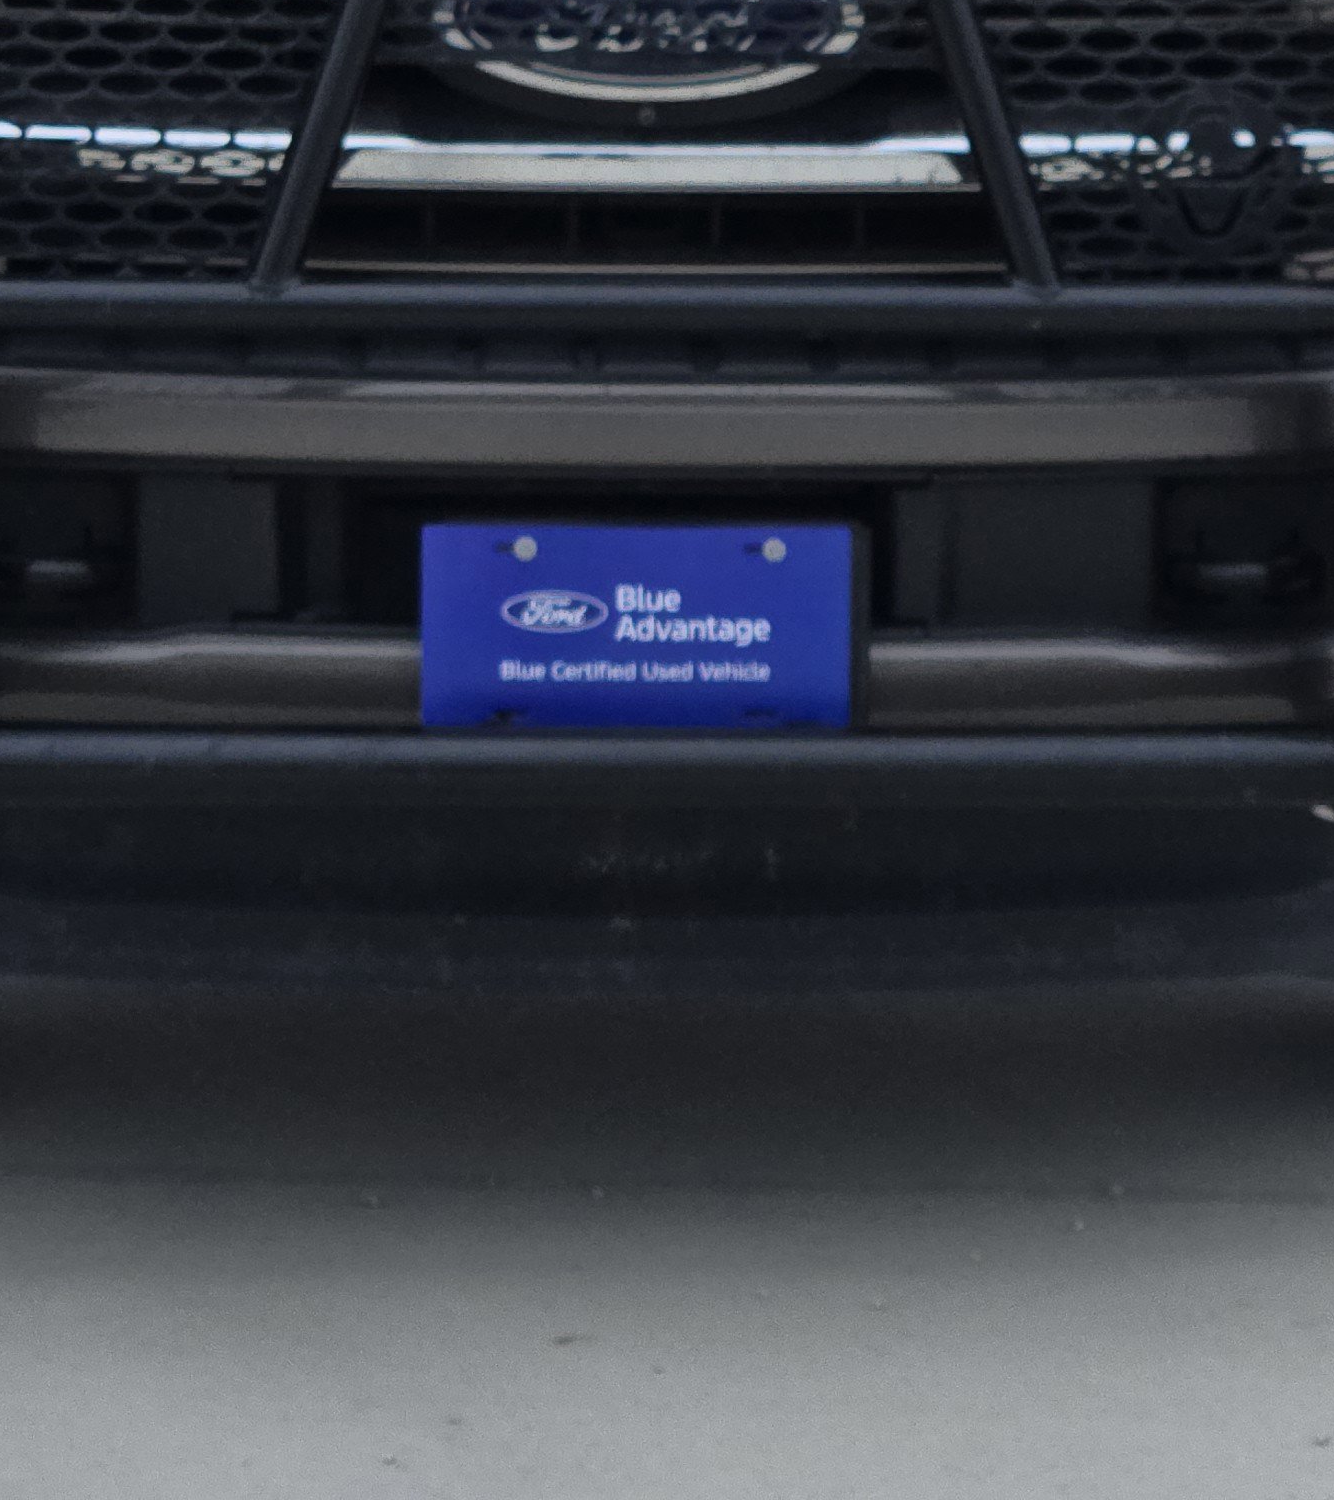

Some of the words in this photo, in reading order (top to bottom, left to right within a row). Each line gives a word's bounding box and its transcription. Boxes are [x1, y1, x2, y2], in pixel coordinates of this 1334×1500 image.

[519, 597, 589, 629] Ford
[614, 583, 682, 613] Blue
[614, 616, 772, 648] Advantage
[499, 660, 546, 682] Blue
[551, 660, 637, 682] Certified
[641, 660, 695, 682] Used
[699, 660, 772, 683] Vehicle
